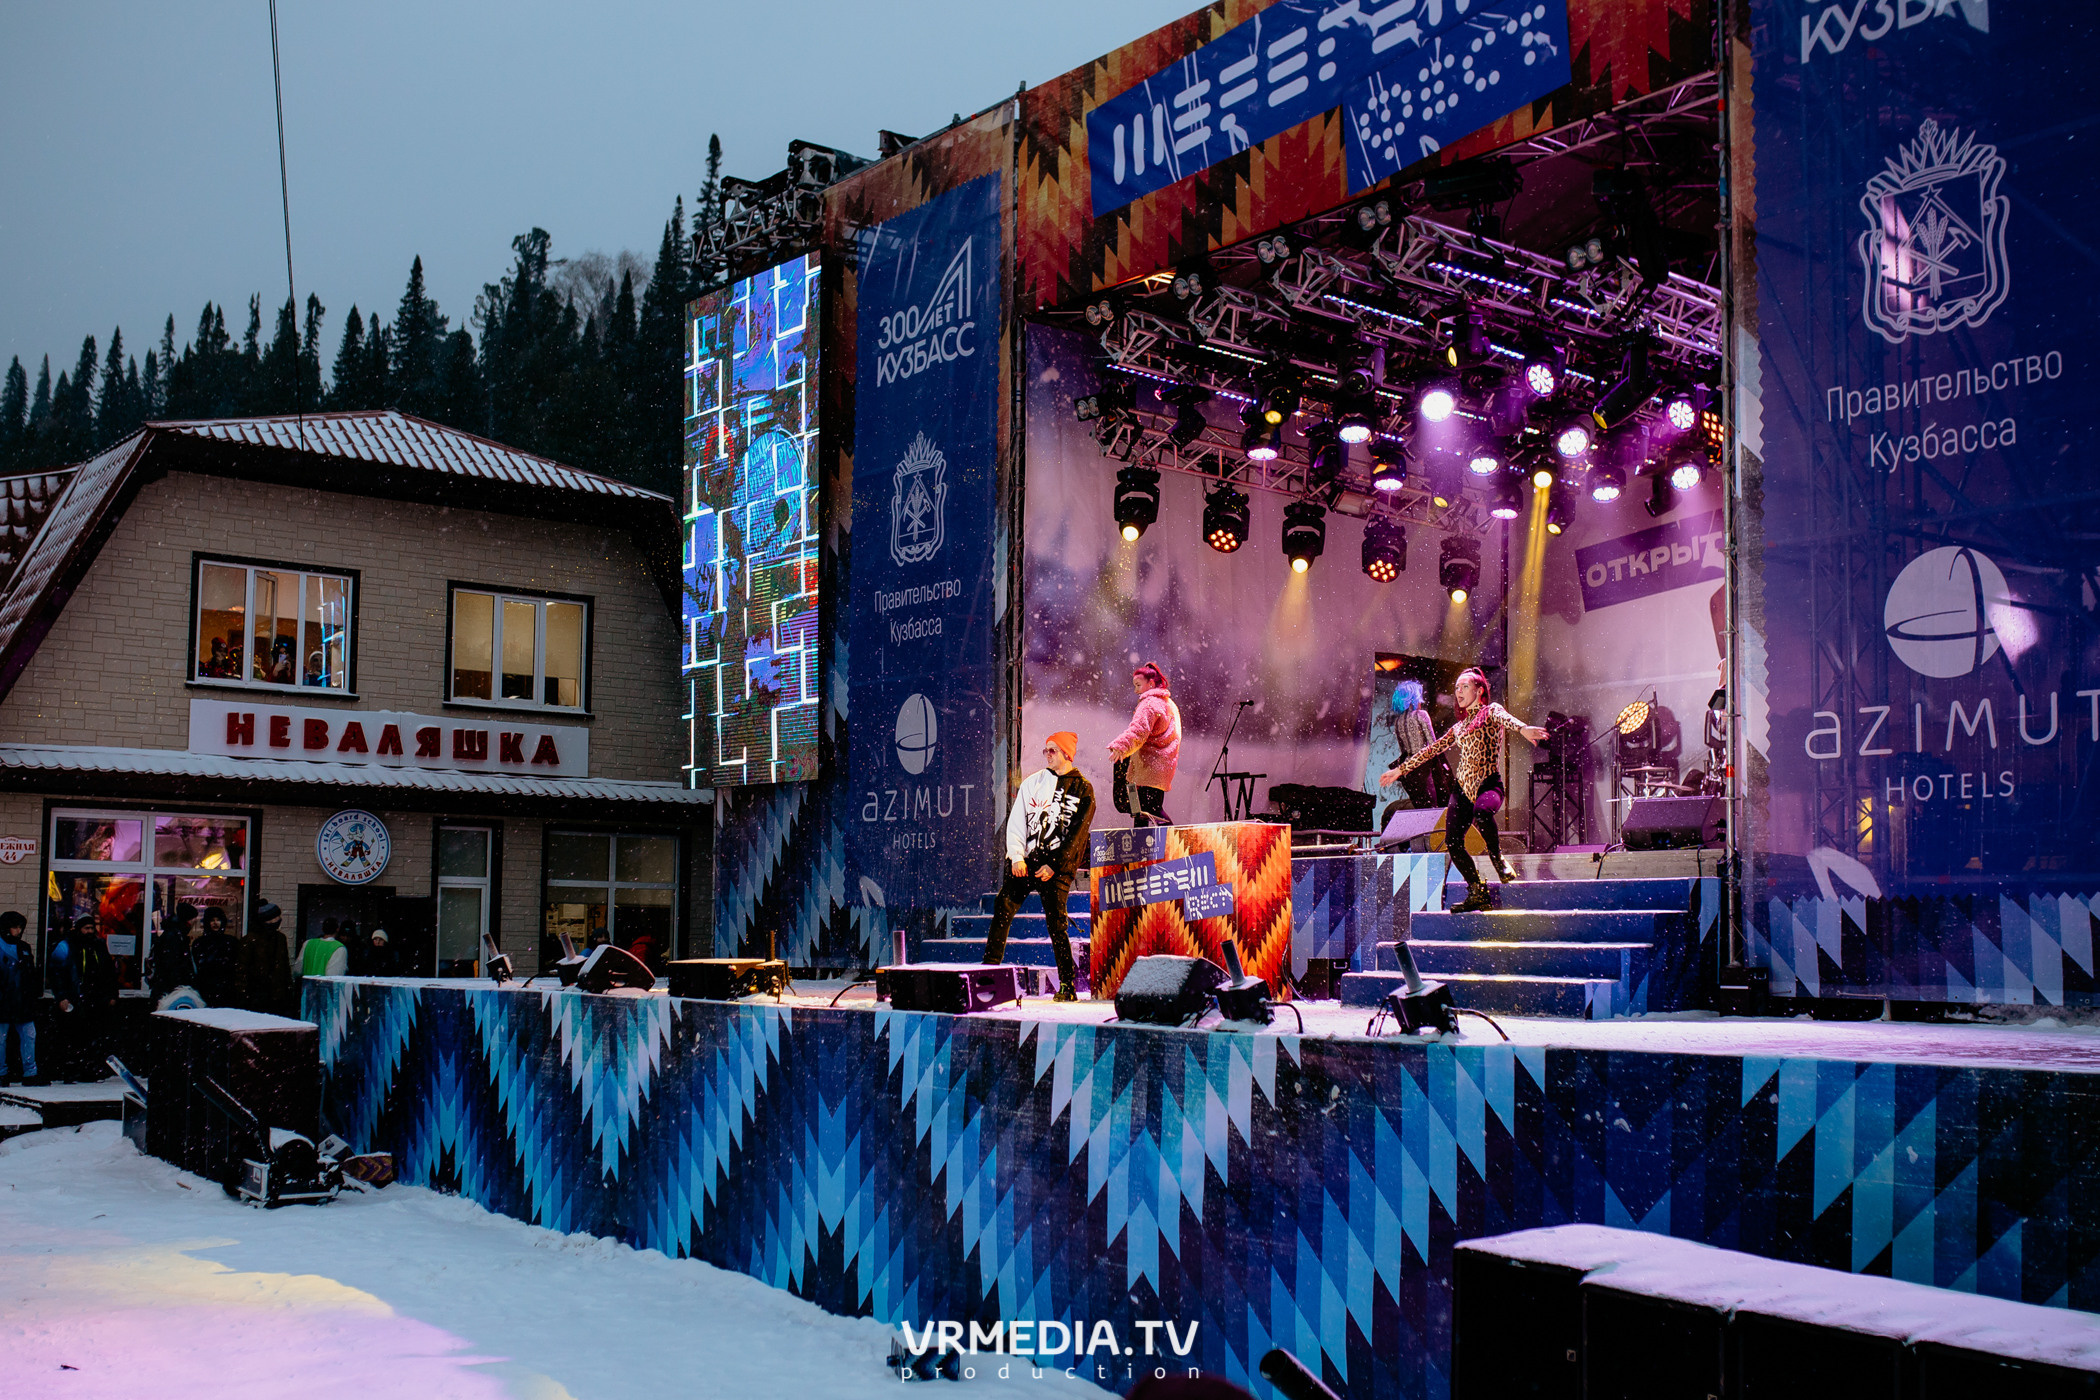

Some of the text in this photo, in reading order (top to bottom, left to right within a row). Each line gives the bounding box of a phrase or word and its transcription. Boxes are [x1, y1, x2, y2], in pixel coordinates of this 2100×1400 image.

[878, 302, 954, 349] 300 ЛЕТ
[877, 322, 975, 388] КУЗБАСС
[1826, 350, 2063, 425] Правительство
[1869, 417, 2017, 473] Кузбасса
[874, 579, 961, 615] Правительство
[890, 617, 942, 647] Кузбасса
[226, 712, 560, 765] НЕВАЛЯШКА
[1886, 770, 2014, 802] HOTELS
[324, 813, 386, 842] ski-board school
[892, 832, 936, 849] HOTELS
[3, 851, 17, 861] 44
